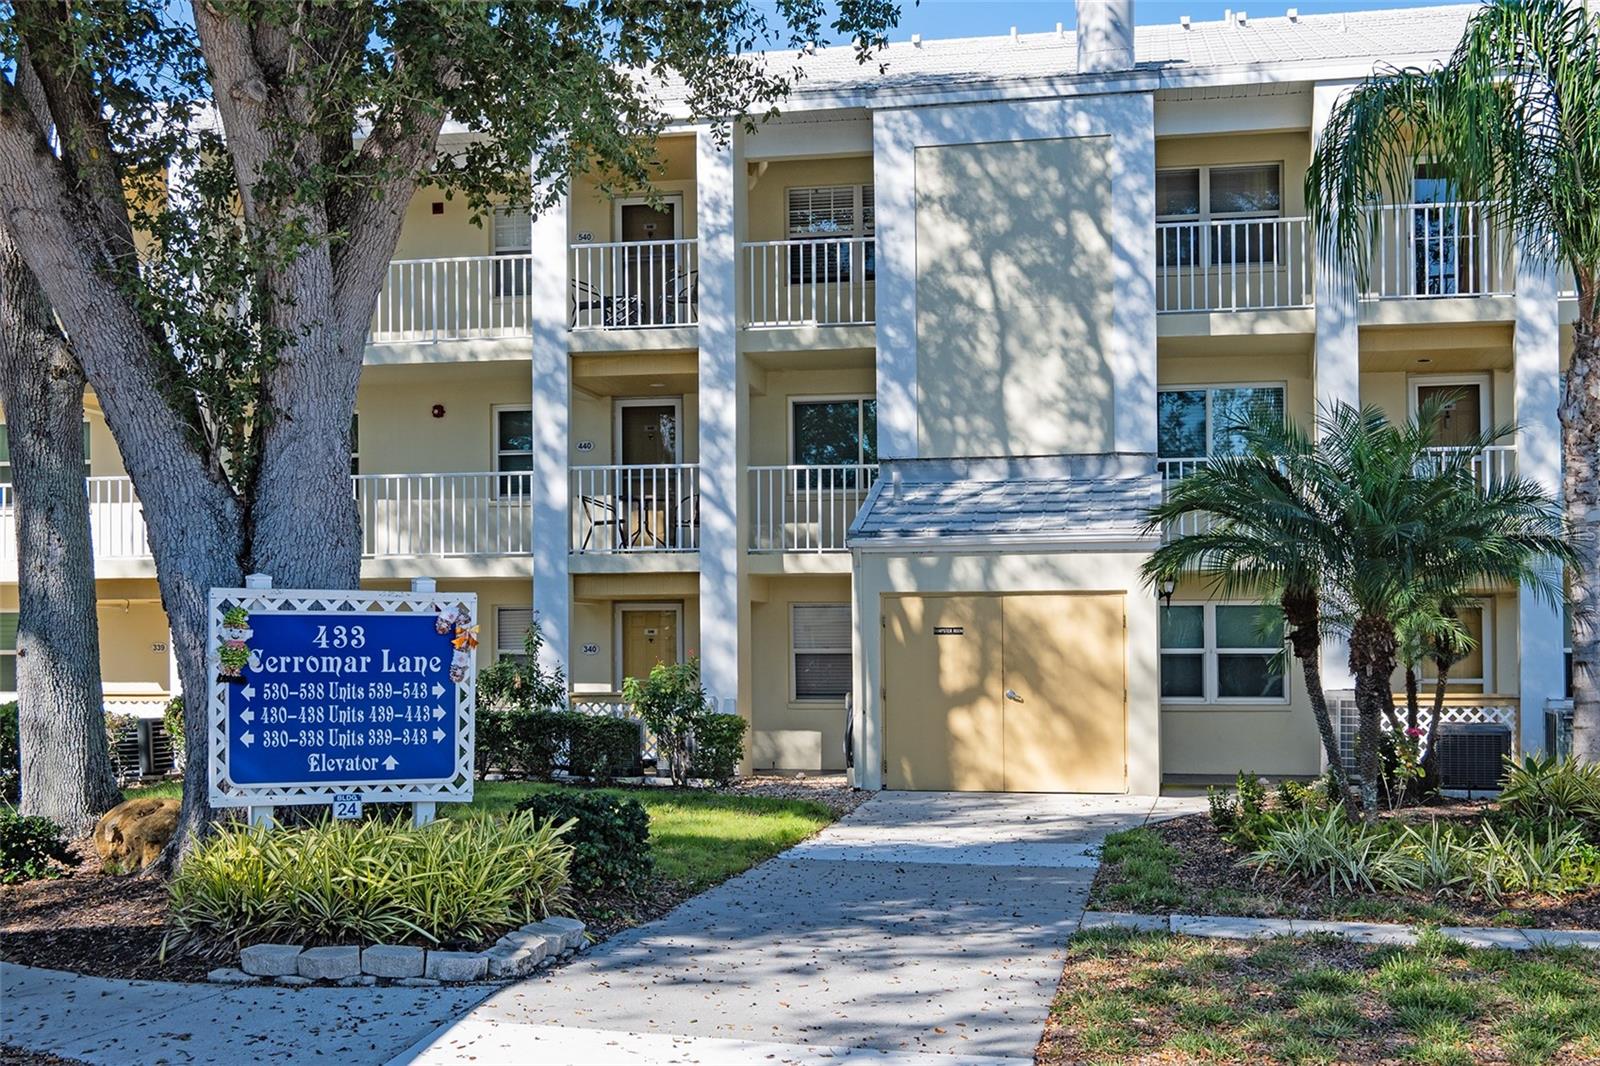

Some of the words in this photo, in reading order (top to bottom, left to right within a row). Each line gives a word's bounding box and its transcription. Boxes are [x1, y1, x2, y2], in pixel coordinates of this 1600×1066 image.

[578, 233, 592, 241] 540
[312, 625, 366, 649] 433
[583, 645, 597, 653] 340
[249, 649, 372, 677] Cerromar
[380, 649, 442, 677] Lane
[263, 682, 325, 700] 530-538
[328, 681, 365, 702] Units
[368, 682, 428, 699] 539-543
[260, 706, 325, 724] 430-438
[328, 705, 365, 726] Units
[368, 705, 431, 723] 439-443
[263, 729, 325, 747] 330-338
[328, 728, 365, 749] Units
[368, 728, 428, 746] 339-343
[307, 753, 379, 772] Elevator
[338, 802, 358, 816] 24
